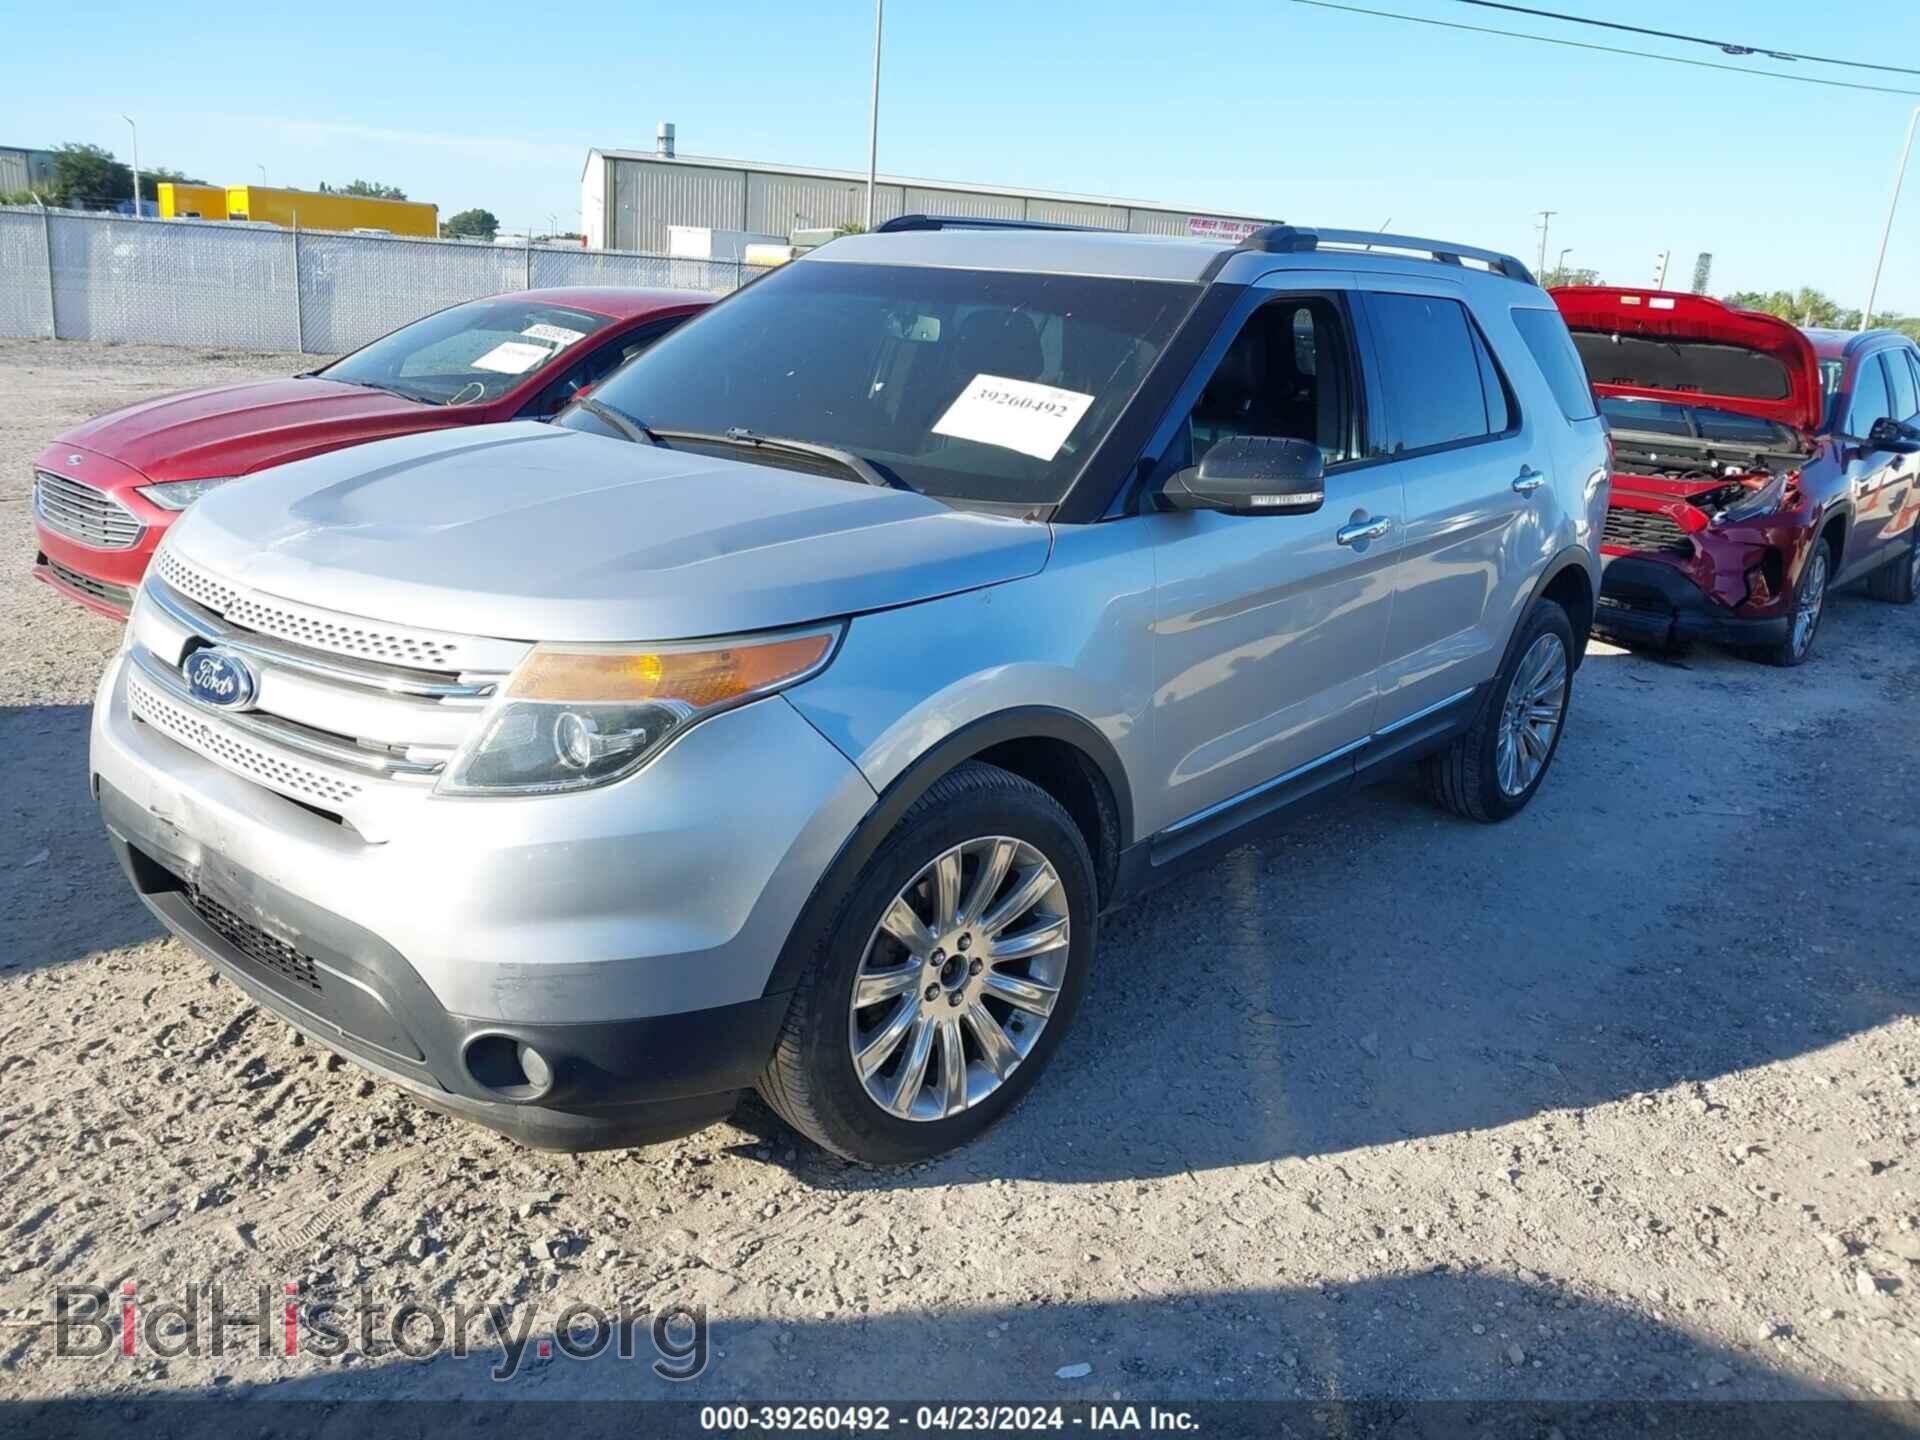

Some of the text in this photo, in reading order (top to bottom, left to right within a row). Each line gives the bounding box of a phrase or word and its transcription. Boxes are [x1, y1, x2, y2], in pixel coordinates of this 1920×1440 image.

[1189, 218, 1217, 230] PREMIER
[1220, 221, 1240, 232] TRUCK
[977, 388, 1068, 418] 39260492
[194, 658, 234, 695] Ford
